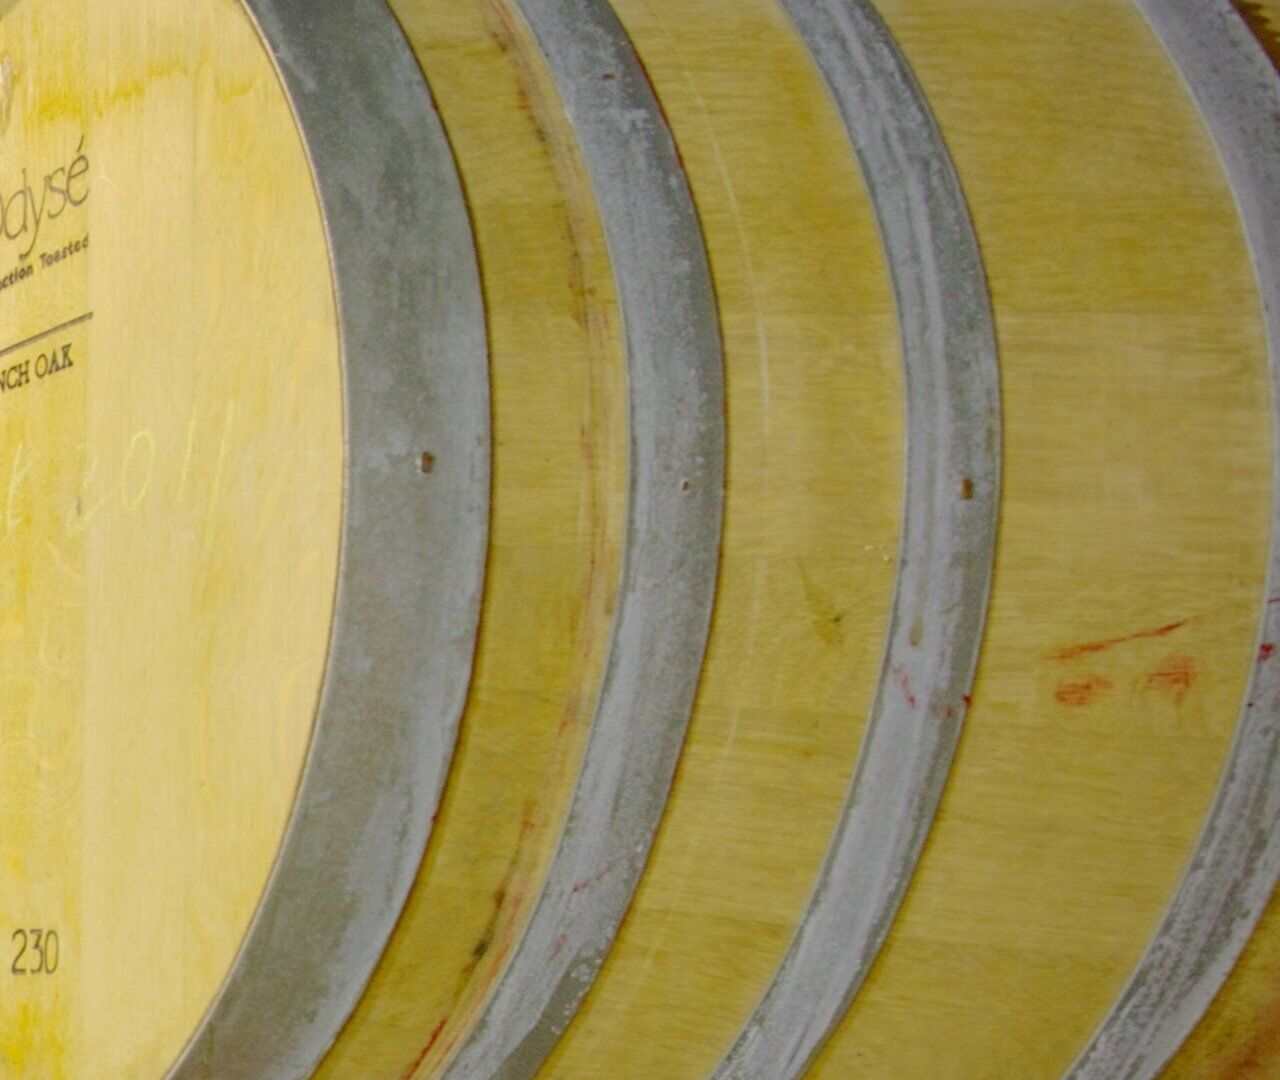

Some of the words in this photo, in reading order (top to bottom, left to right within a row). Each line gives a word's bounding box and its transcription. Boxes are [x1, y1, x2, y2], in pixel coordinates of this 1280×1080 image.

[39, 233, 90, 269] Toasted
[34, 343, 74, 379] OAK
[11, 928, 60, 975] 230
